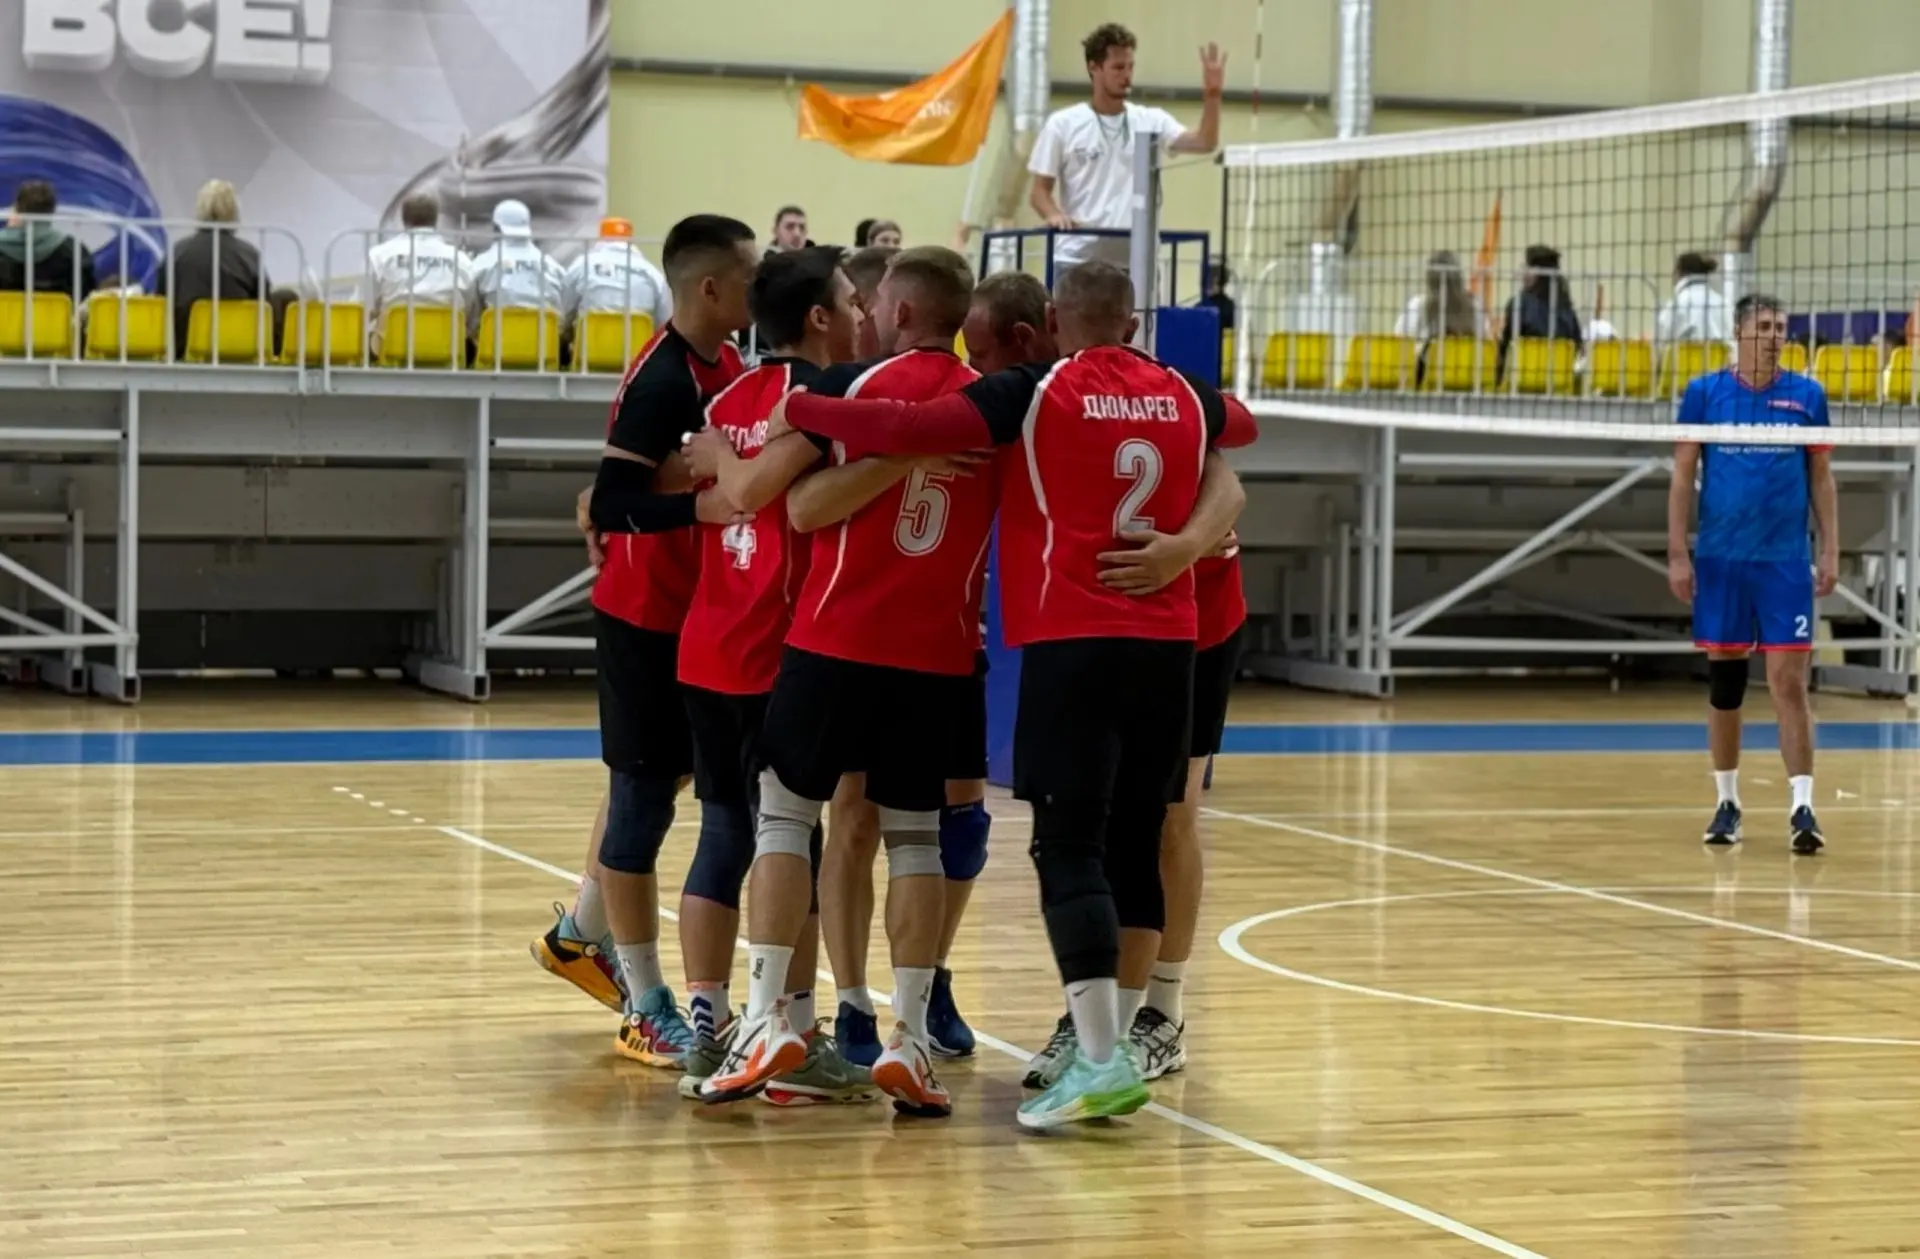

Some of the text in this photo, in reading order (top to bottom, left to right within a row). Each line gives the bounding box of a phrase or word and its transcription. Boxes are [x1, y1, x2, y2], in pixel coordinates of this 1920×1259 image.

[1082, 394, 1180, 422] ДЮКАРЕВ
[893, 466, 955, 557] 5
[1112, 438, 1164, 538] 2
[721, 523, 757, 570] 4
[1794, 614, 1809, 638] 2
